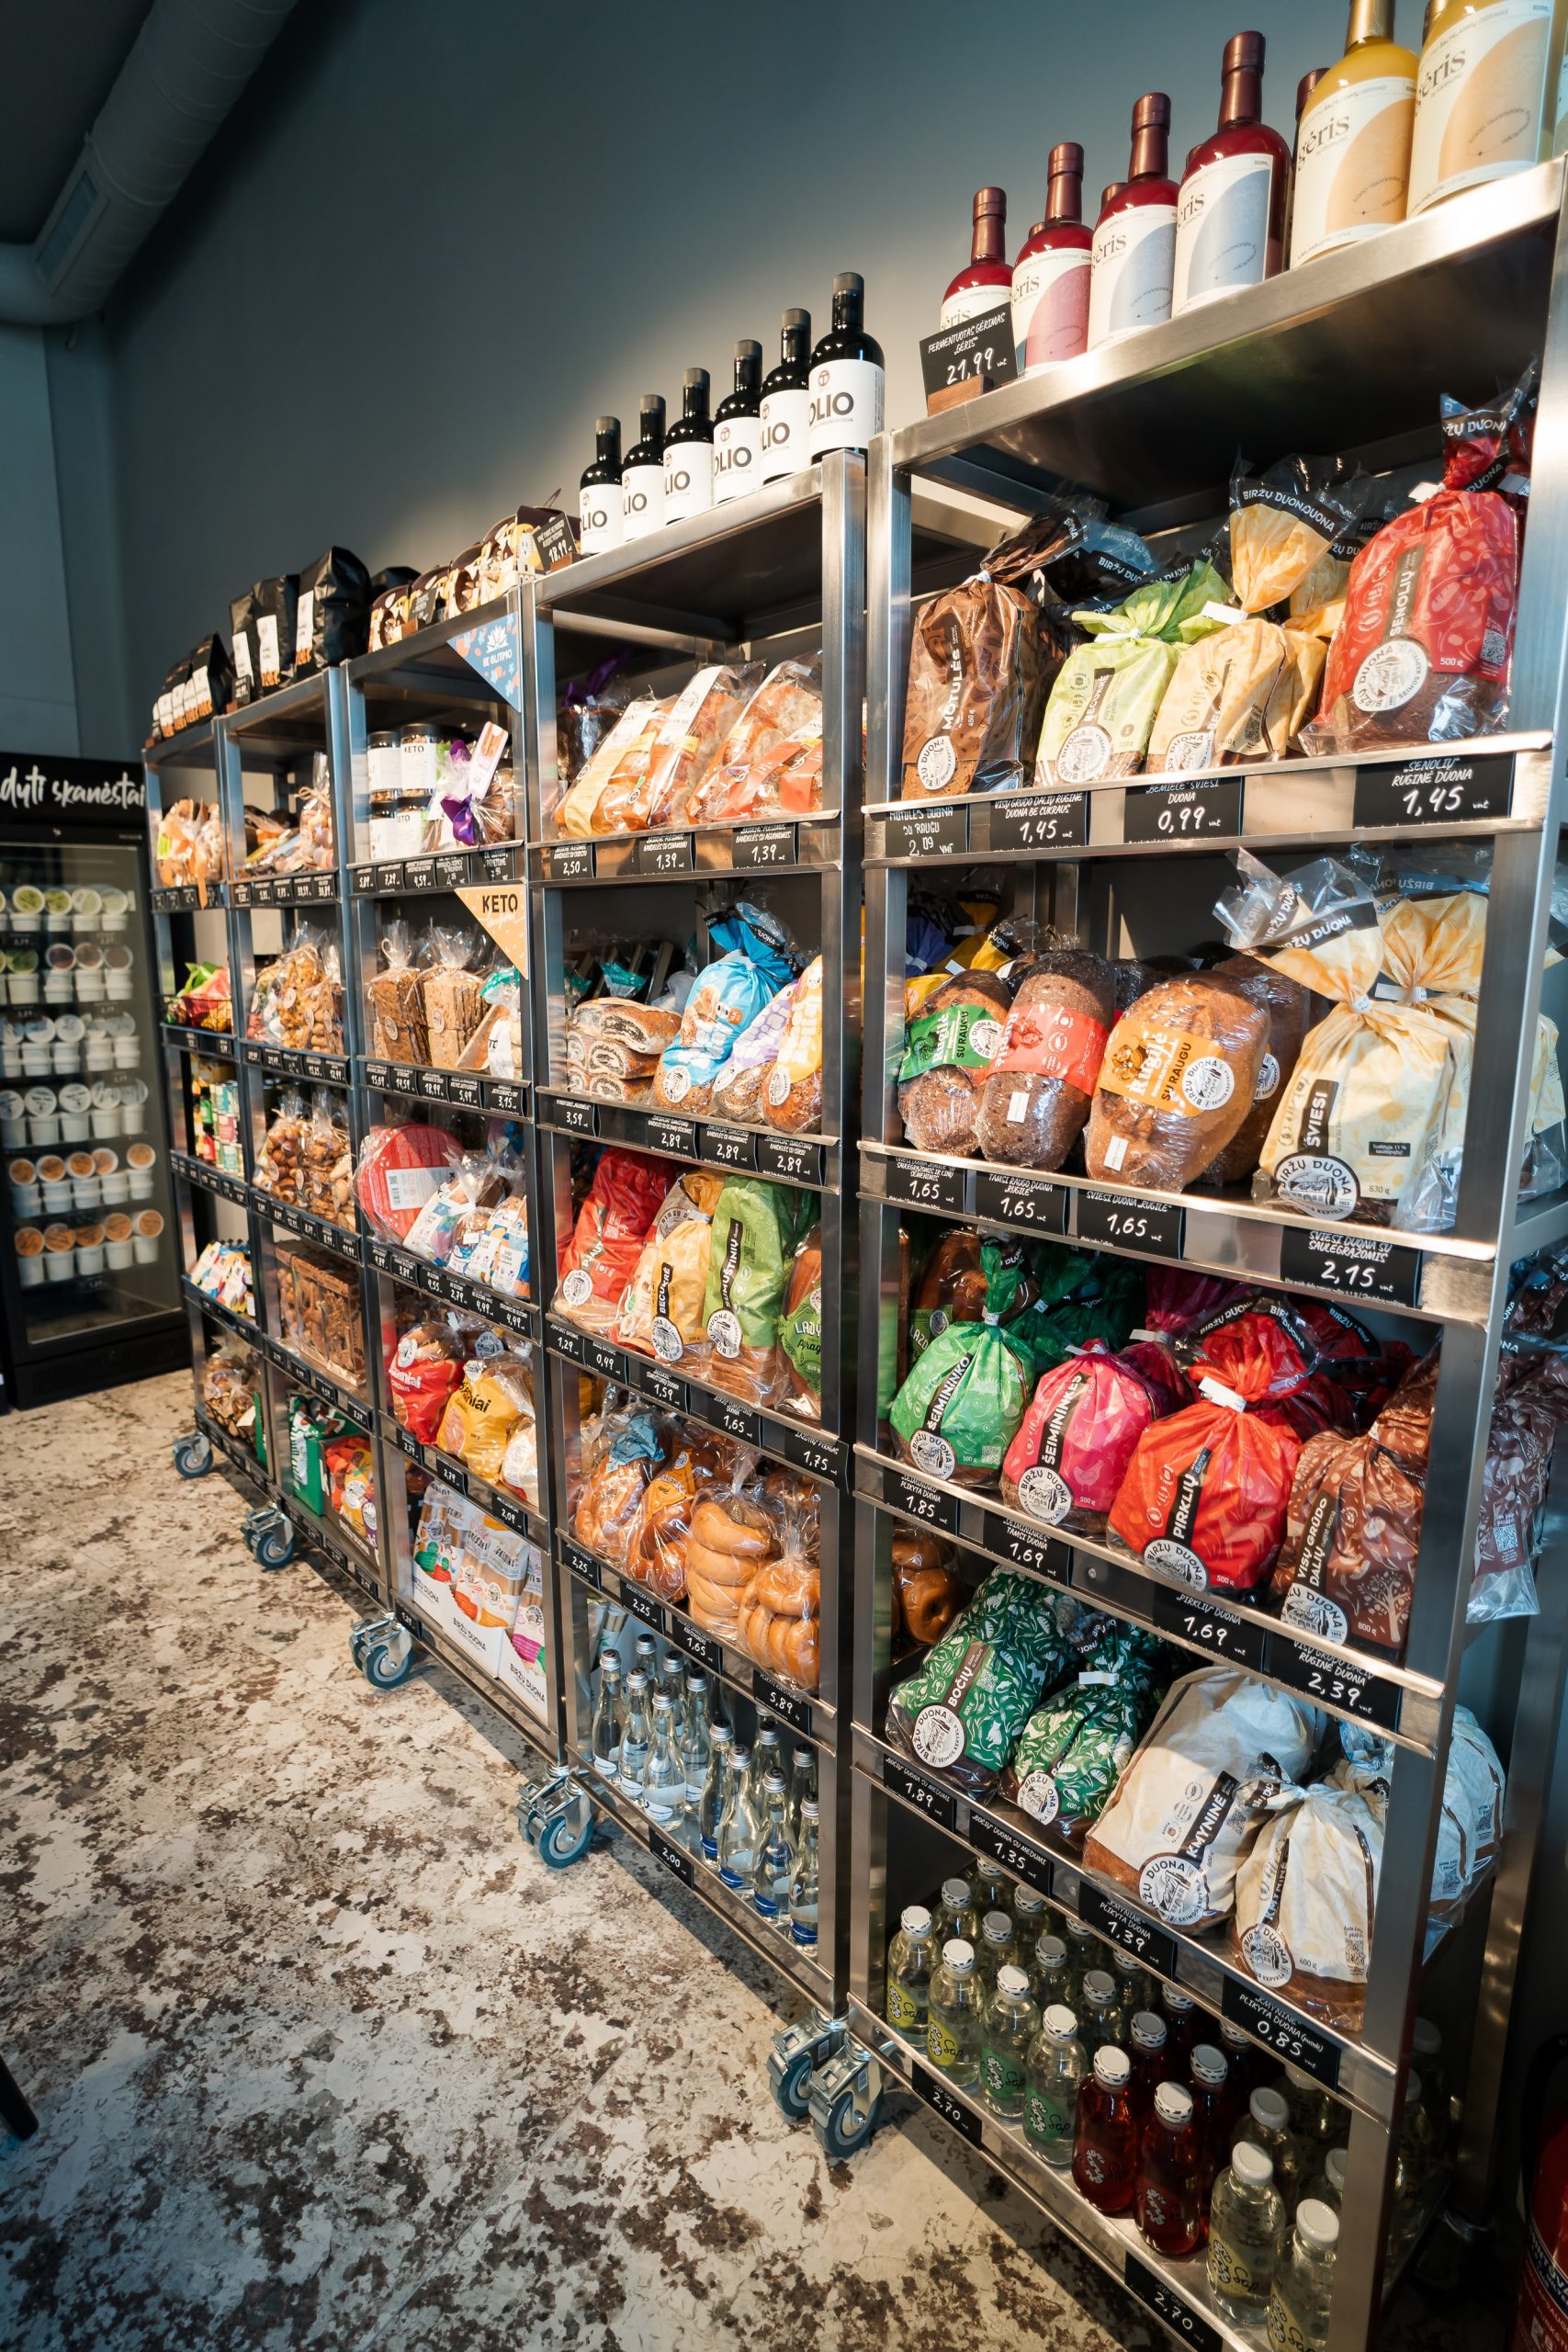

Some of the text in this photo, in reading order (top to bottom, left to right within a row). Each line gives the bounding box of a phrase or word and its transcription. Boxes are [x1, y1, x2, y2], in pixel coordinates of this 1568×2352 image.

[928, 311, 1007, 355] FERMENTUOTAS GĖRIMAS
[946, 347, 994, 385] 21,99
[1466, 463, 1504, 493] DUONA
[1243, 489, 1274, 501] BIRŽŲ
[1098, 557, 1124, 576] BIRŽŲ
[1390, 571, 1415, 637] SENOLIŲ
[490, 649, 513, 667] GLITIMO
[1359, 645, 1394, 684] DUONA
[1439, 657, 1456, 666] 500
[942, 648, 963, 730] MOTULĖS
[1391, 767, 1473, 786] RUGINĖ DUONA
[51, 772, 145, 809] skanėstai
[1168, 791, 1197, 805] DUONA
[1402, 786, 1490, 817] 1,45 vnt
[397, 815, 411, 823] ETO
[1005, 804, 1071, 819] DUONA BE CUKRAUS
[1158, 807, 1205, 832] 0,99
[1019, 820, 1057, 842] 1,45
[751, 844, 777, 864] 1,39
[482, 894, 518, 914] KETO
[1314, 915, 1354, 943] DUONA
[957, 1011, 971, 1058] SU RAUGU
[1130, 1031, 1168, 1096] Rugilė
[1161, 1042, 1192, 1102] SU RAUGU
[1187, 1057, 1218, 1079] DUONA
[1303, 1091, 1328, 1148] ŠVIESI
[777, 1155, 802, 1174] 2,89
[1313, 1159, 1353, 1197] DUONA
[909, 1181, 940, 1199] 1,65
[988, 1174, 1053, 1193] TAMSI RAUGO DUONA
[1000, 1197, 1034, 1219] 1,65
[1109, 1195, 1137, 1207] DUONA
[1106, 1214, 1148, 1238] 1,65
[1342, 1235, 1393, 1254] DUONA SU
[721, 1238, 739, 1308] SUMUŠTINIŲ
[1321, 1261, 1376, 1288] 2,15
[659, 1267, 671, 1315] BECUKRĖ
[1282, 1316, 1306, 1351] DUONA
[653, 1384, 673, 1401] 1,59
[927, 1356, 970, 1431] ŠEIMININKO
[723, 1415, 745, 1433] 1,65
[1042, 1374, 1082, 1465] ŠEIMININKĖS
[803, 1450, 829, 1471] 1,75
[929, 1438, 953, 1464] DUONA
[922, 1487, 942, 1503] DUONA
[1021, 1470, 1068, 1505] BIRŽŲ DUONA
[1079, 1496, 1090, 1504] 500
[906, 1496, 935, 1517] 1,85
[1173, 1473, 1198, 1540] PIRKLIŲ
[1006, 1528, 1048, 1550] TAMSI DUONA
[1298, 1498, 1328, 1579] VISŲ GRŪDO
[1010, 1543, 1043, 1568] 1,69
[1147, 1544, 1202, 1582] BIRŽŲ DUONA
[1309, 1547, 1325, 1588] DALIŲ
[1216, 1575, 1229, 1585] 500
[632, 1599, 650, 1617] 2,25
[1213, 1606, 1241, 1624] DUONA
[1306, 1593, 1344, 1630] DUONA
[468, 1631, 487, 1652] DUONA
[1183, 1616, 1228, 1645] 1,69
[687, 1637, 706, 1657] 1,65
[510, 1662, 546, 1702] BIRŽŲ DUONA
[947, 1666, 973, 1708] BOČIŲ
[1333, 1664, 1367, 1687] DUONA
[770, 1691, 793, 1713] 5,89
[1307, 1673, 1360, 1707] 2,39
[912, 1708, 948, 1759] BIRŽŲ DUONA
[903, 1767, 951, 1802] DUONA MEDUMI
[905, 1781, 934, 1808] 1,89
[1185, 1792, 1227, 1860] KMYNINĖ
[662, 1848, 681, 1869] 2,00
[991, 1825, 1012, 1844] DUONA
[1020, 1844, 1047, 1865] MEDUMI
[994, 1842, 1025, 1871] 1,35
[1146, 1860, 1186, 1882] DUONA
[1100, 1901, 1152, 1939] PLIKYTA DUONA
[1108, 1920, 1145, 1953] 1,39
[1263, 1928, 1290, 1965] DUONA
[1299, 1956, 1312, 1967] 400
[903, 2001, 922, 2020] Sap
[1240, 1993, 1303, 2040] PLIKYTA DUONA
[943, 2038, 964, 2059] Sap
[1257, 2020, 1303, 2058] 0,85
[932, 2091, 961, 2121] 2,70
[1048, 2113, 1070, 2134] Sap
[1233, 2265, 1259, 2295] Sap
[1154, 2294, 1194, 2331] 2,70
